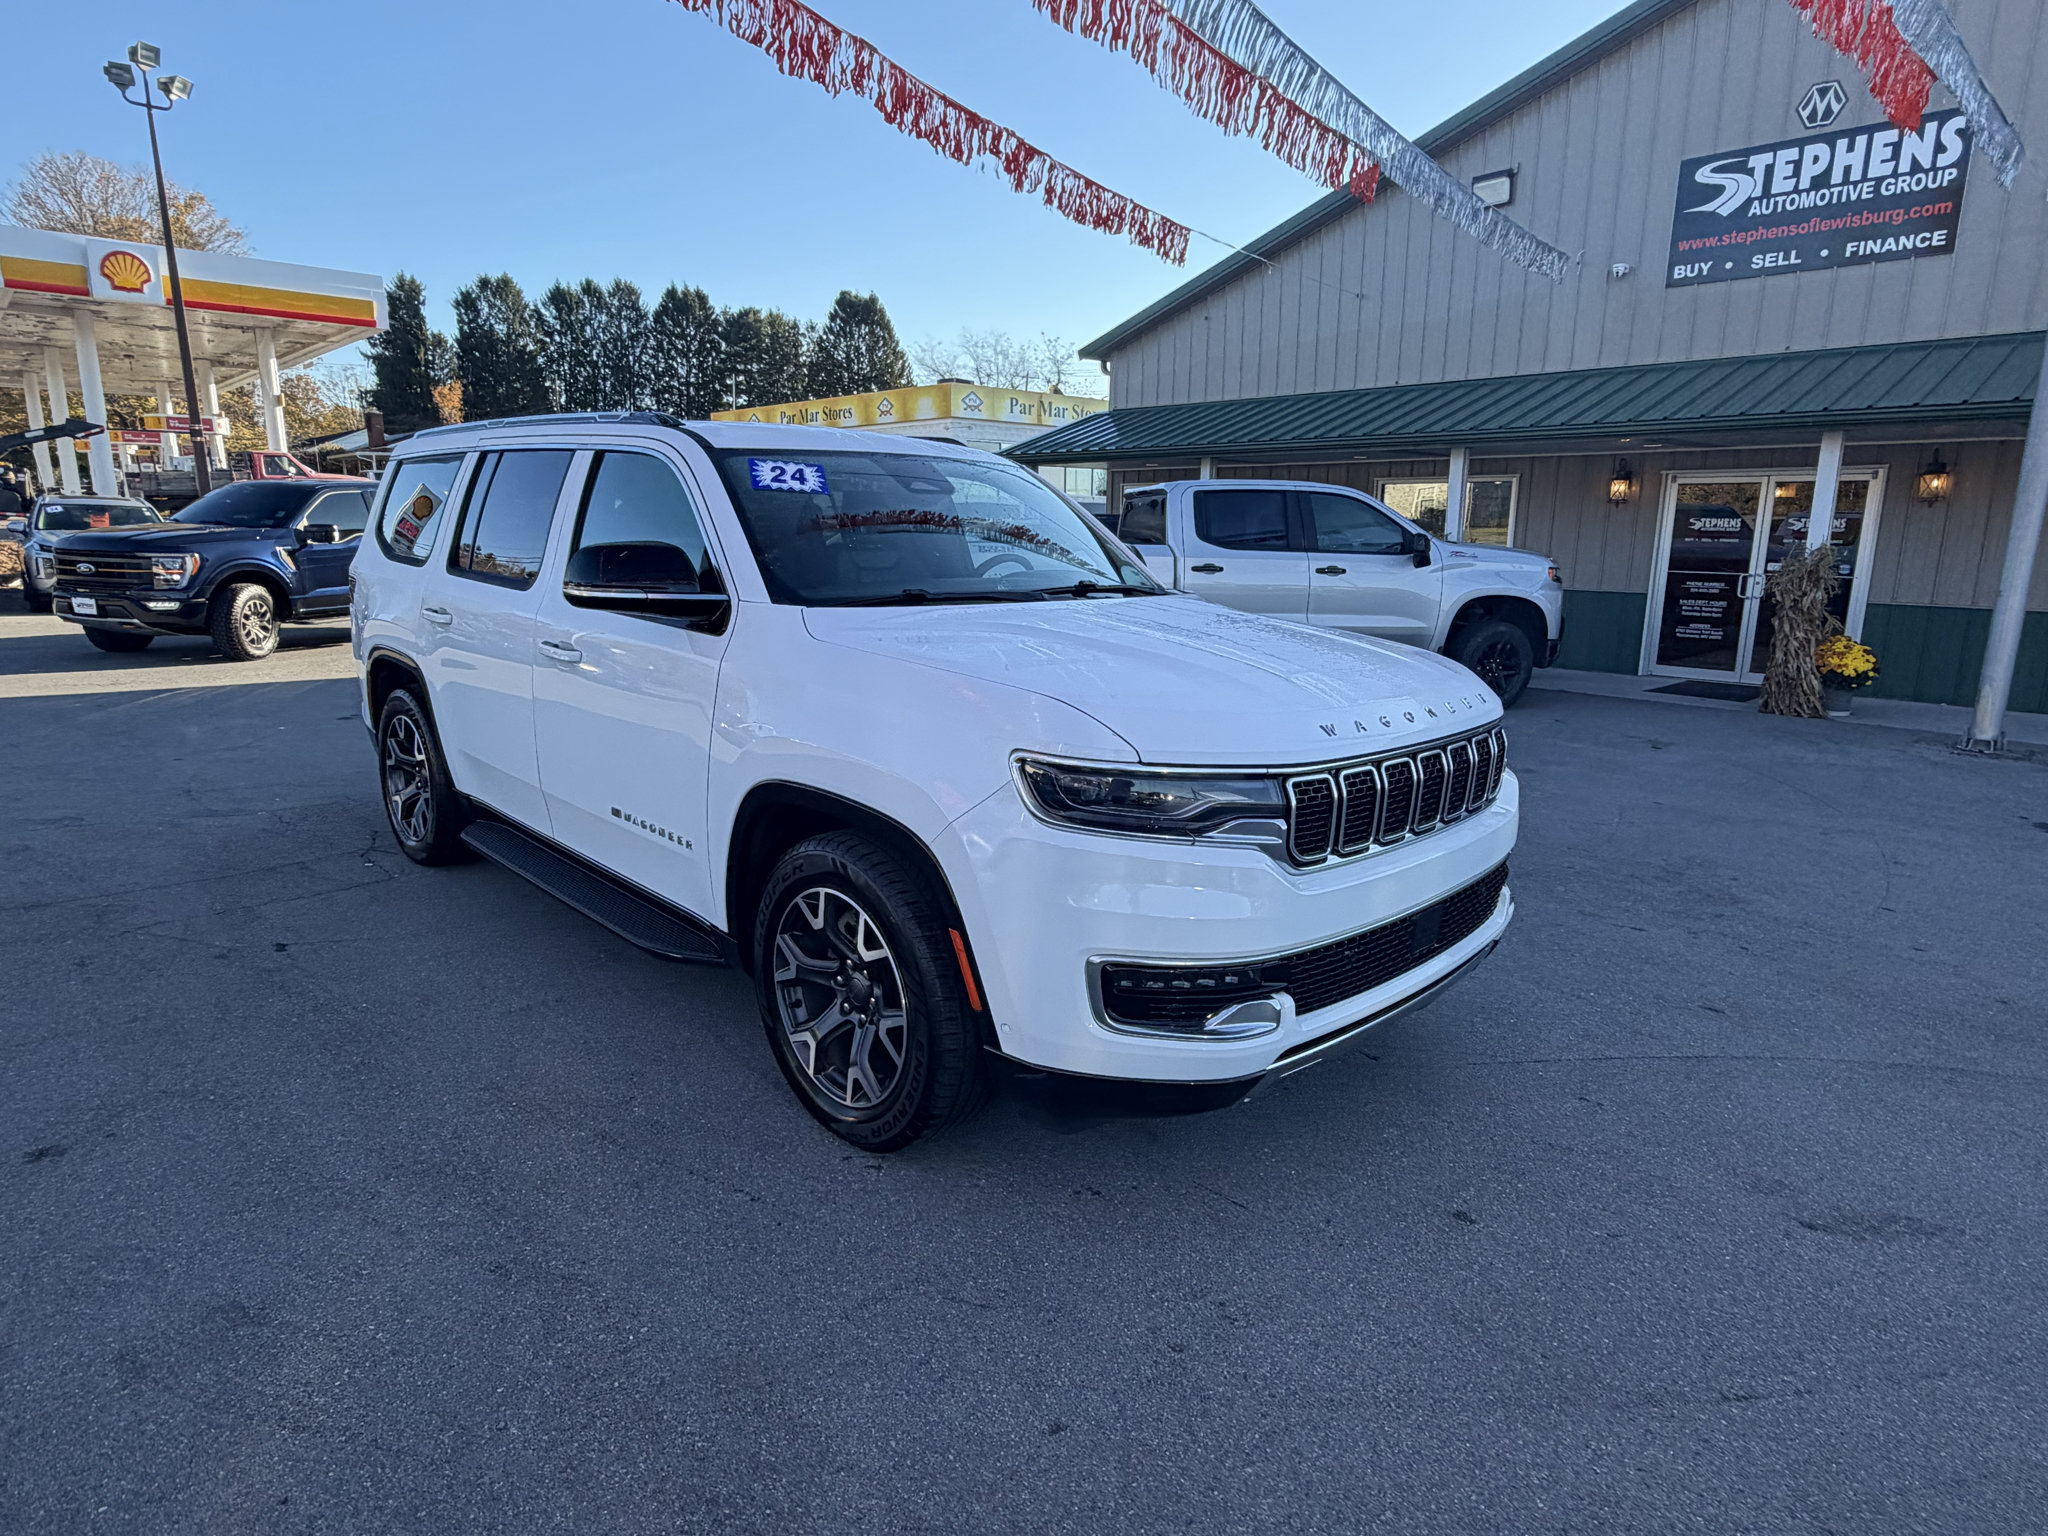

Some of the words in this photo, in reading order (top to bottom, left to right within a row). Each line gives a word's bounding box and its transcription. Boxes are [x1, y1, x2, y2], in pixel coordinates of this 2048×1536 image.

[1683, 115, 1966, 216] STEPHENS
[1748, 181, 1876, 217] AUTOMOTIVE
[1880, 167, 1958, 196] GROUP
[1678, 201, 1953, 251] www.stephensoflewisburg.com
[1673, 261, 1713, 279] BUY
[1750, 249, 1802, 269] SELL
[1844, 229, 1949, 258] FINANCE
[780, 410, 797, 424] Par
[799, 408, 820, 424] Mar
[822, 405, 853, 421] Stores
[1009, 396, 1035, 417] Par
[1039, 399, 1069, 419] Mar
[770, 465, 809, 486] 24
[1688, 517, 1741, 530] STEPHENS
[1319, 692, 1488, 738] WAGONEER
[623, 811, 694, 850] WAGONEER
